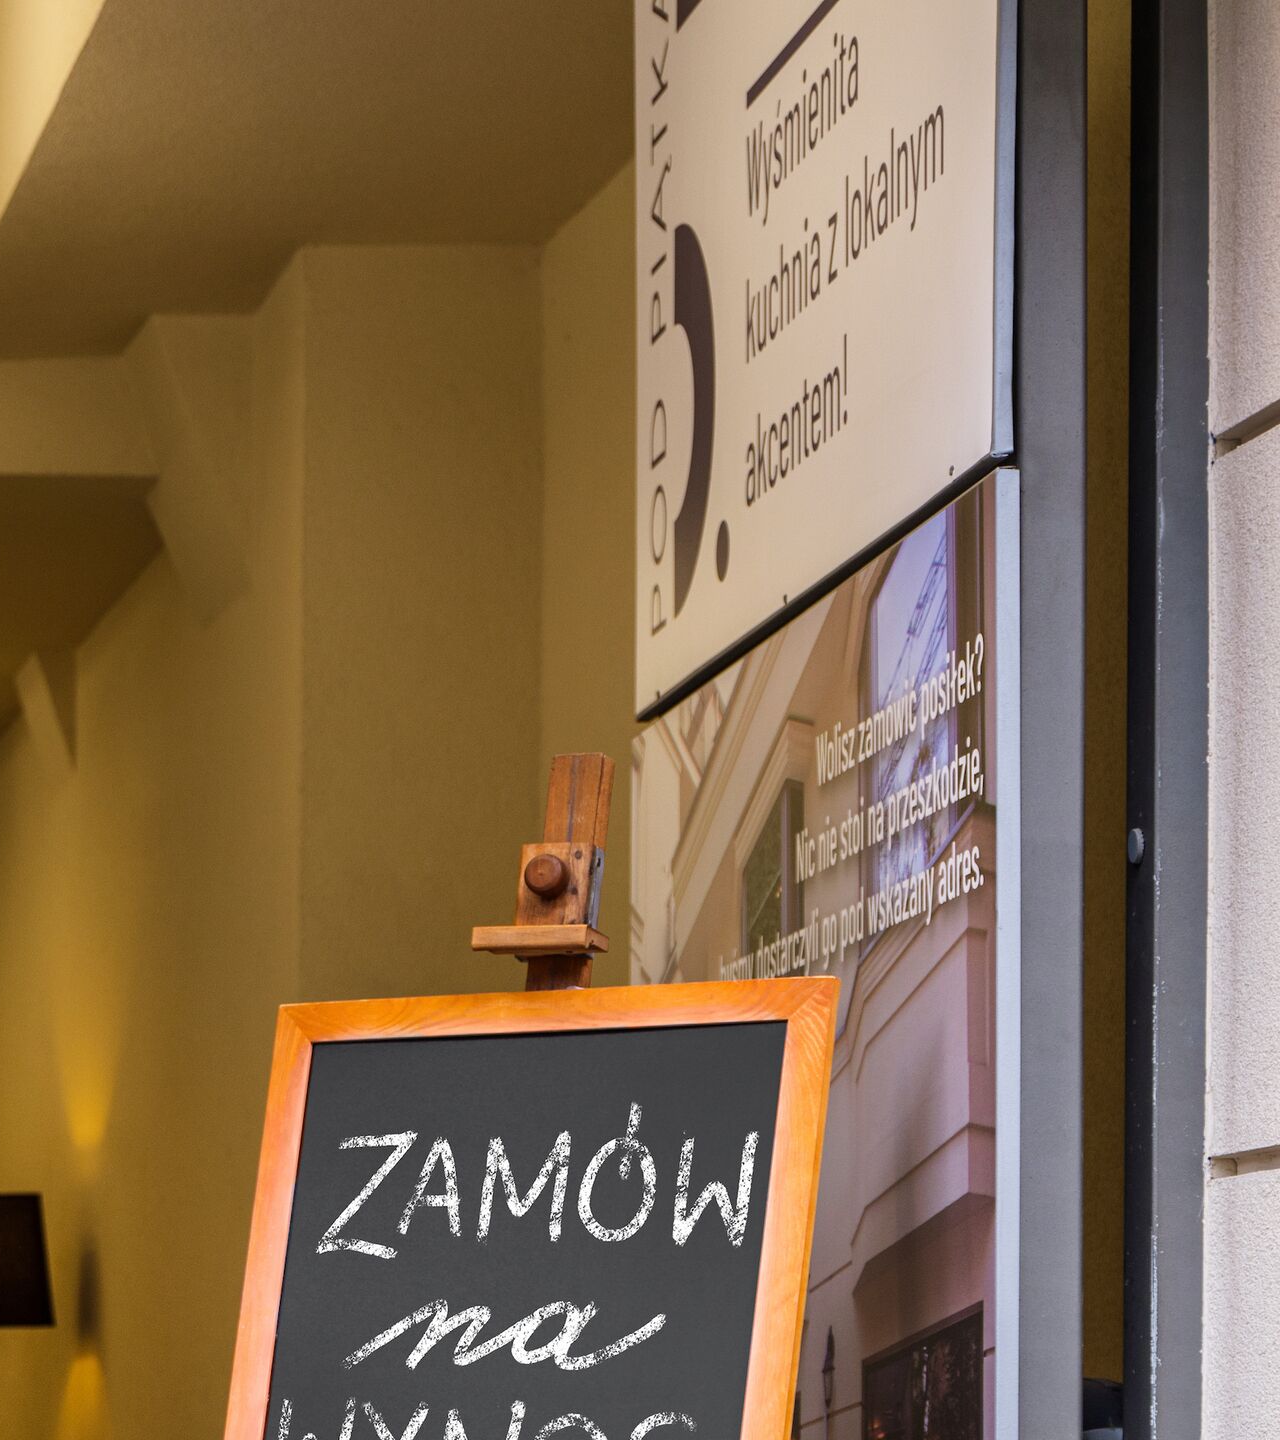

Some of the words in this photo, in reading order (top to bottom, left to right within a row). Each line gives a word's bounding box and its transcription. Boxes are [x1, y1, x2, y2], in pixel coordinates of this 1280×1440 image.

[746, 32, 859, 227] Wyśmienita
[745, 217, 821, 364] kuchnia
[827, 211, 839, 285] z
[845, 104, 944, 268] lokalnym
[745, 333, 848, 507] akcentem!
[650, 398, 668, 637] POD
[815, 720, 855, 787] Wolisz
[920, 633, 984, 741] posiłek?
[796, 827, 816, 884] Nic
[818, 815, 838, 872] nie
[840, 796, 865, 861] stoi
[868, 800, 884, 847] na
[888, 736, 984, 850] przeszkodzie,
[756, 907, 820, 978] dostarczyli
[821, 912, 838, 970] go
[840, 886, 864, 963] pod
[867, 866, 936, 937] wskazany
[938, 841, 985, 905] adres.
[314, 1101, 760, 1260] ZAMÓW
[342, 1298, 667, 1371] na
